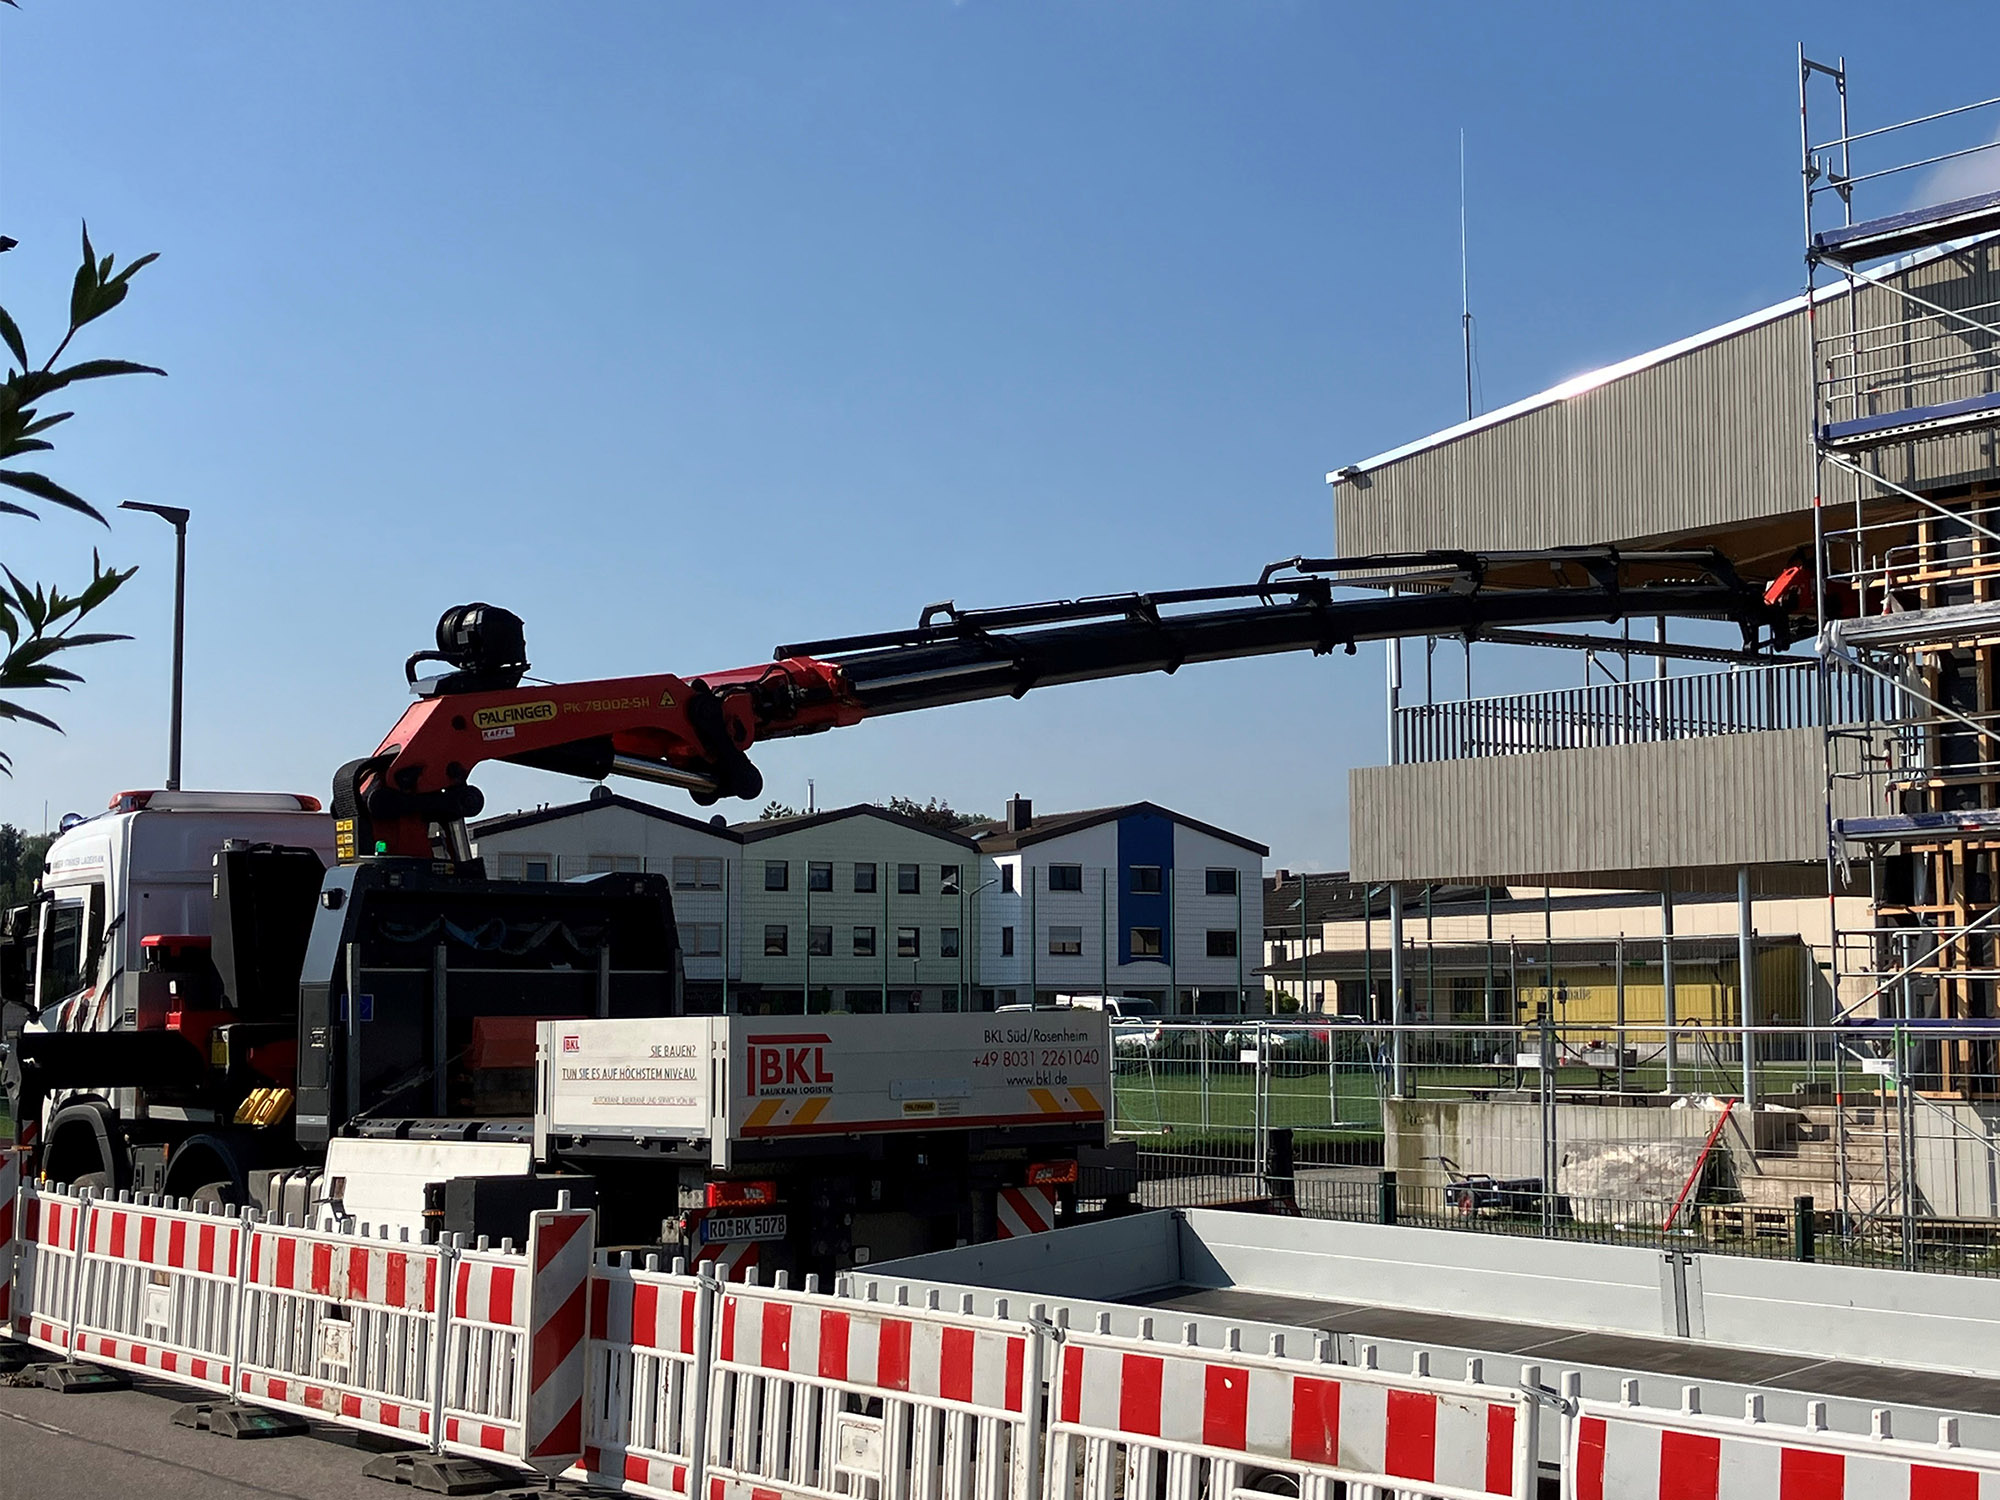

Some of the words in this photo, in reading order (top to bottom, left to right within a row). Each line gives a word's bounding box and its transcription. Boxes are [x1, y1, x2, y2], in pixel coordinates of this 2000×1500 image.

[563, 703, 581, 714] PK
[584, 697, 650, 711] 78002-SH
[478, 704, 553, 726] PALFINGER
[984, 1030, 1004, 1043] BKL
[1007, 1027, 1088, 1044] Süd/Rosenheim
[650, 1045, 662, 1057] SIE
[664, 1045, 697, 1057] BAUEN?
[972, 1050, 999, 1068] +49
[1003, 1050, 1035, 1067] 8031
[1041, 1048, 1099, 1066] 2261040
[562, 1067, 577, 1079] TUN
[579, 1067, 590, 1080] SIE
[592, 1067, 601, 1080] ES
[602, 1068, 618, 1080] AUF
[620, 1065, 662, 1080] HÖCHSTEM
[665, 1068, 697, 1080] NIVEAU.
[760, 1047, 834, 1085] BKL
[1006, 1070, 1068, 1086] www.bkl.de
[760, 1087, 798, 1096] BAUKRAN
[800, 1086, 834, 1095] LOGISTIK
[709, 1221, 726, 1238] RO
[735, 1219, 752, 1236] BK
[754, 1216, 785, 1234] 5078
